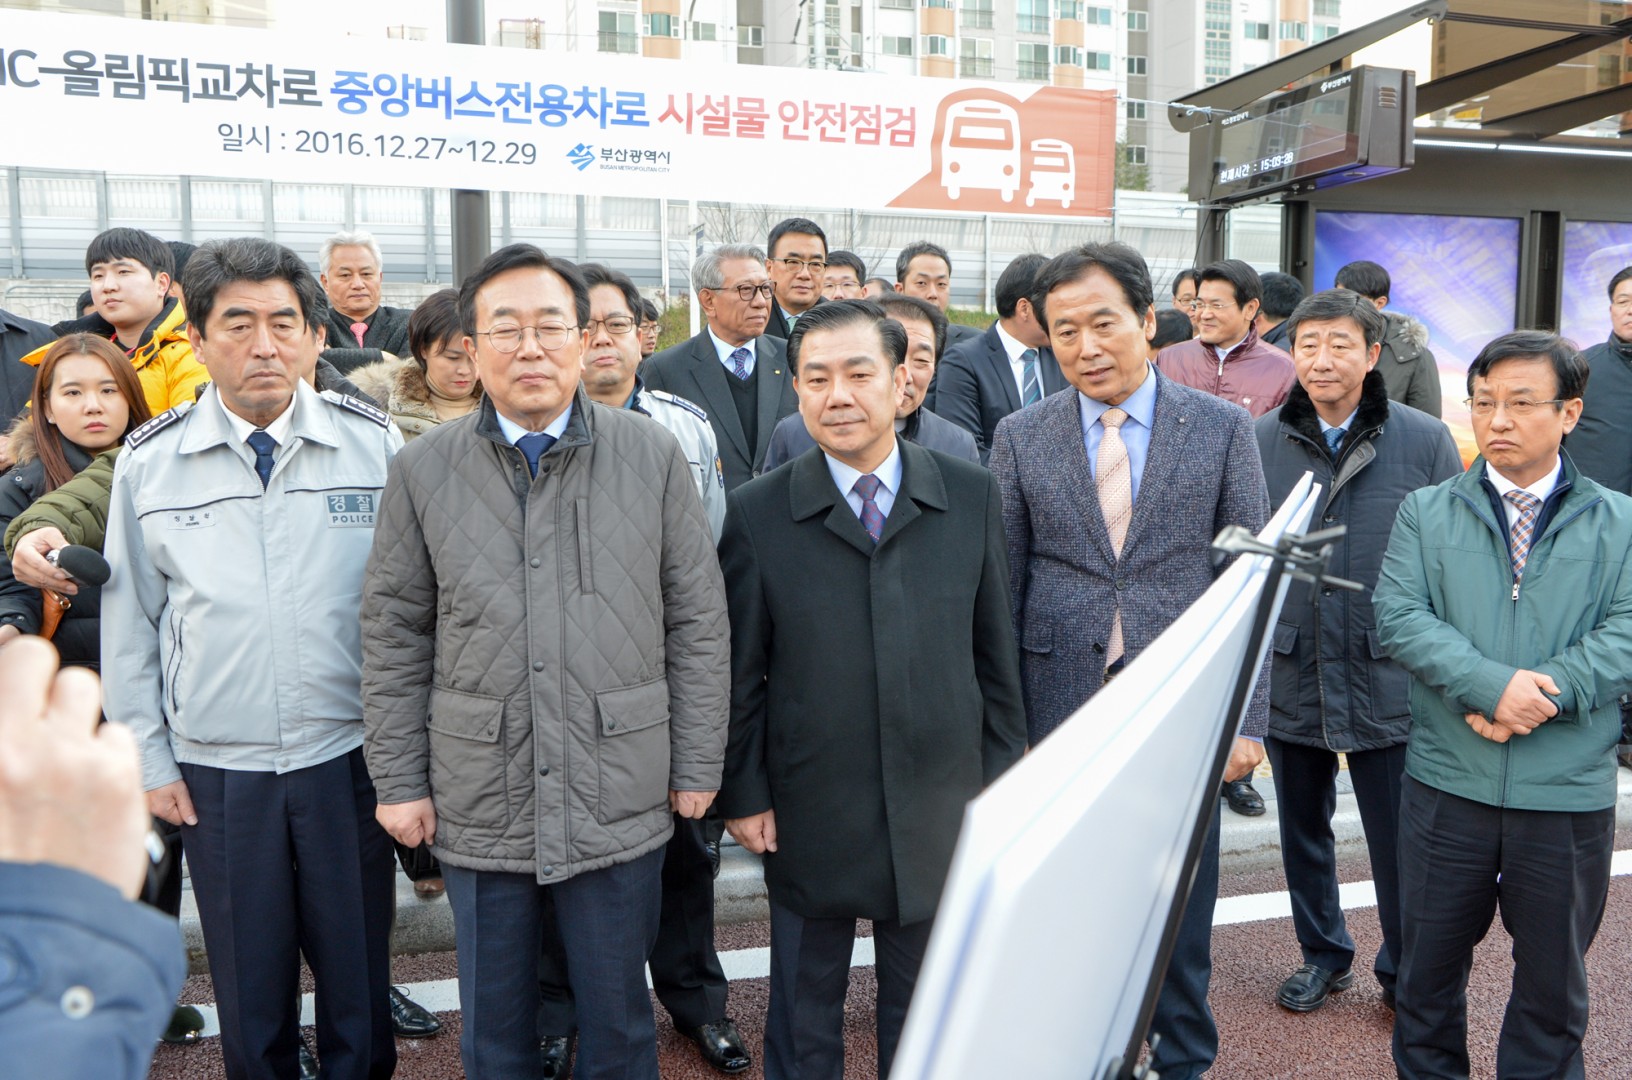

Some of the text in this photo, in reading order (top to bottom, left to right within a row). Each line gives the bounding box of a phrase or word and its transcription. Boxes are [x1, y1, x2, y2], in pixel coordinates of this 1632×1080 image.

[330, 70, 650, 130] 중앙버스전용차로
[658, 92, 770, 139] 시설물
[777, 99, 917, 148] 안전점검
[217, 123, 271, 153] 일시
[295, 129, 537, 166] 2016.12.27~12.29
[600, 147, 671, 165] 부산광역시
[1220, 163, 1250, 183] 현재시간
[330, 495, 371, 512] 경찰
[332, 515, 374, 523] POLICE
